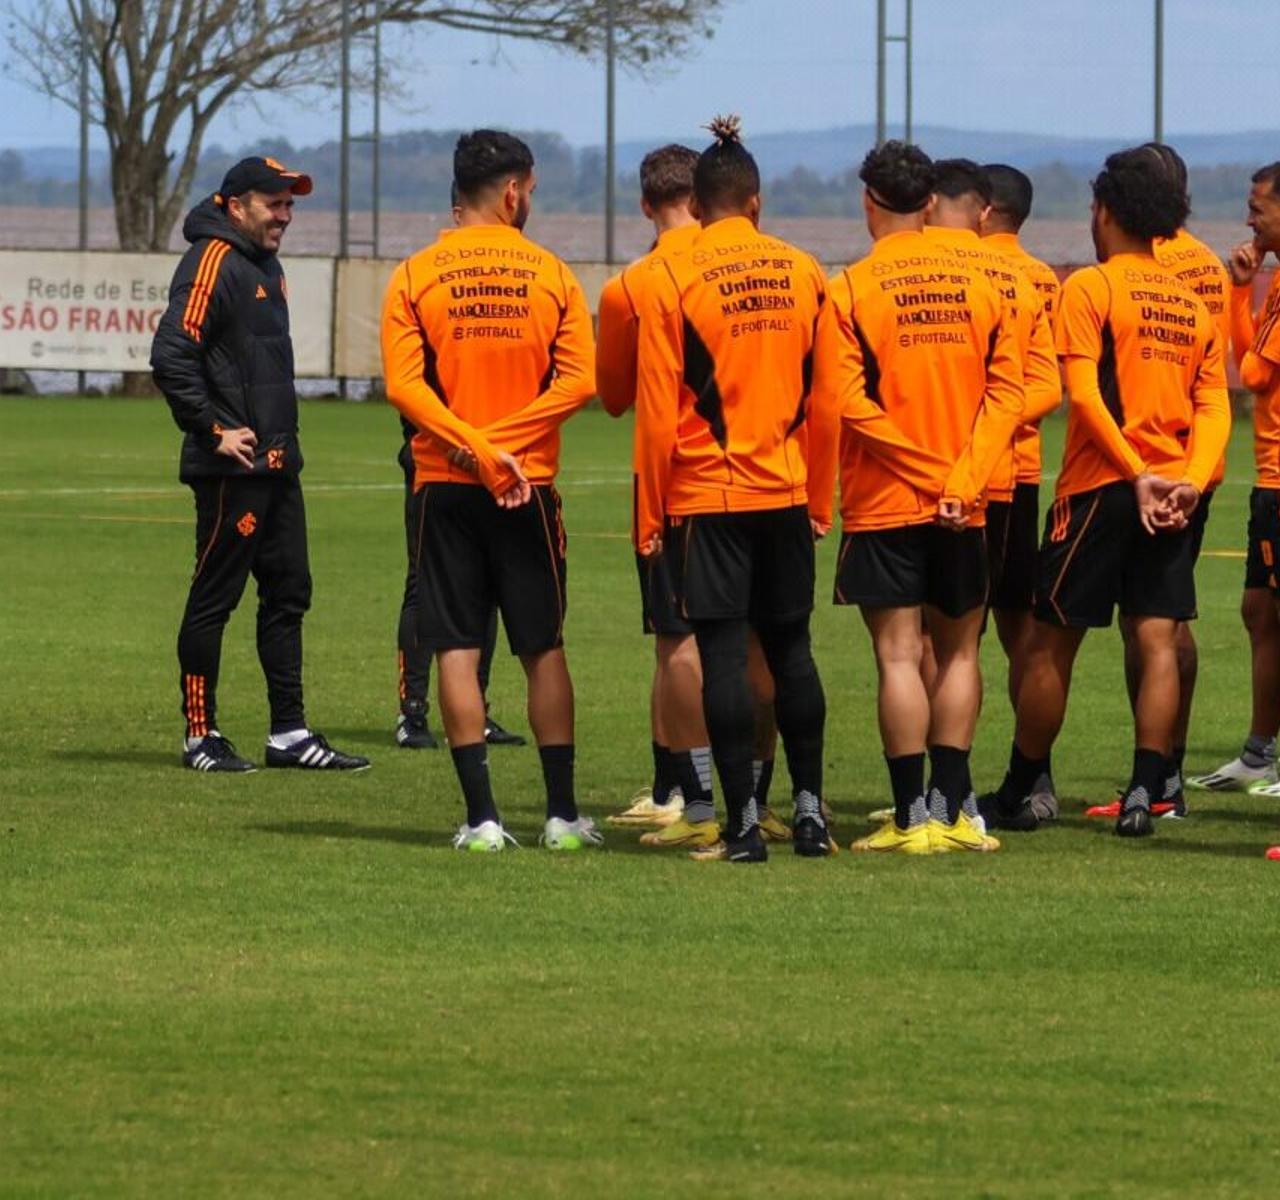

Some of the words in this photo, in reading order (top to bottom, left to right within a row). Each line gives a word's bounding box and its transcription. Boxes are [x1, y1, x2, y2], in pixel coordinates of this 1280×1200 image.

[458, 247, 542, 265] banrisul
[438, 266, 501, 284] ESTRELA
[513, 268, 538, 281] BET
[702, 259, 761, 282] ESTRELA
[772, 259, 793, 270] BET
[28, 277, 85, 300] Rede
[93, 278, 121, 300] de
[450, 281, 528, 299] Unimed
[719, 275, 791, 296] Unimed
[880, 274, 937, 291] ESTRELA
[950, 274, 971, 285] BET
[894, 289, 966, 307] Unimed
[1, 302, 59, 332] SÃO
[1141, 306, 1195, 328] Unimed
